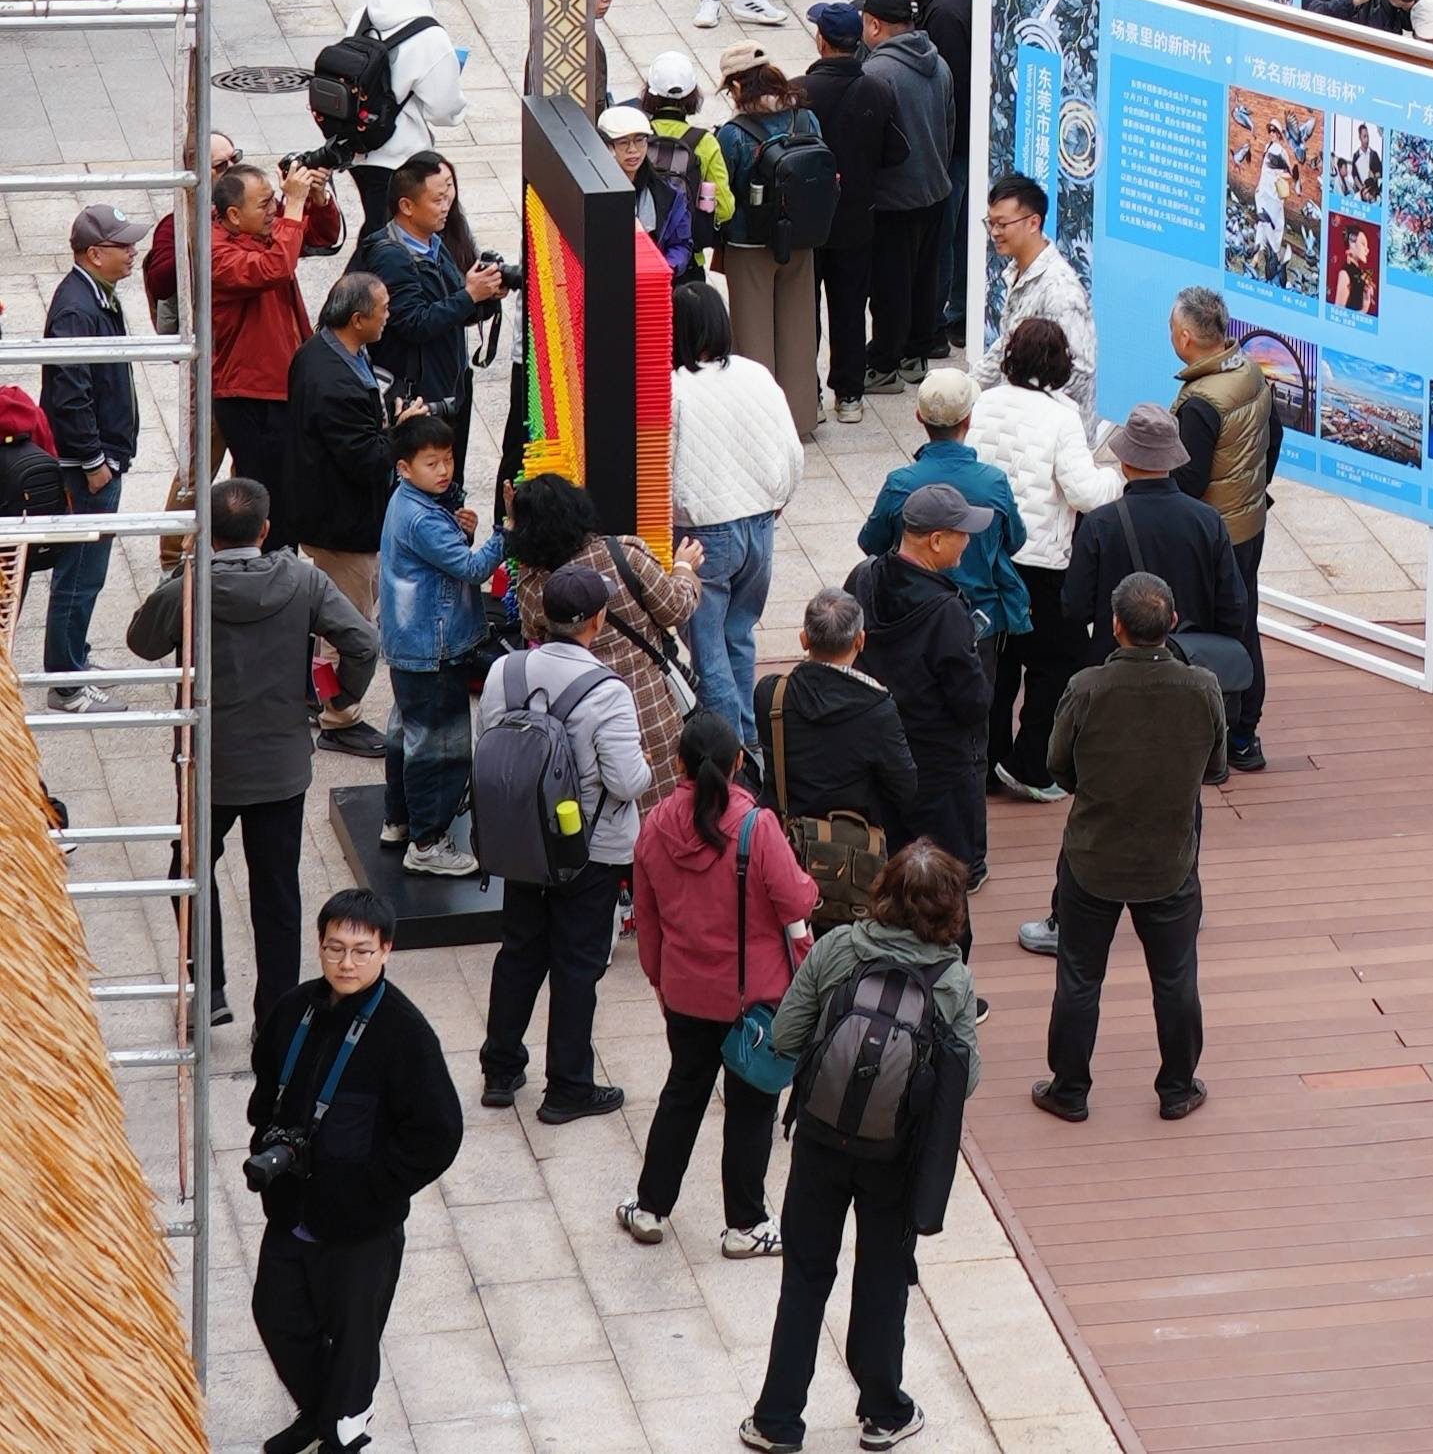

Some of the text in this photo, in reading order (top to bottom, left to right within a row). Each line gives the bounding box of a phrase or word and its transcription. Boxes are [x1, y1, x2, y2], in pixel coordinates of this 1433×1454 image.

[1111, 18, 1212, 64] 场景里的新时代
